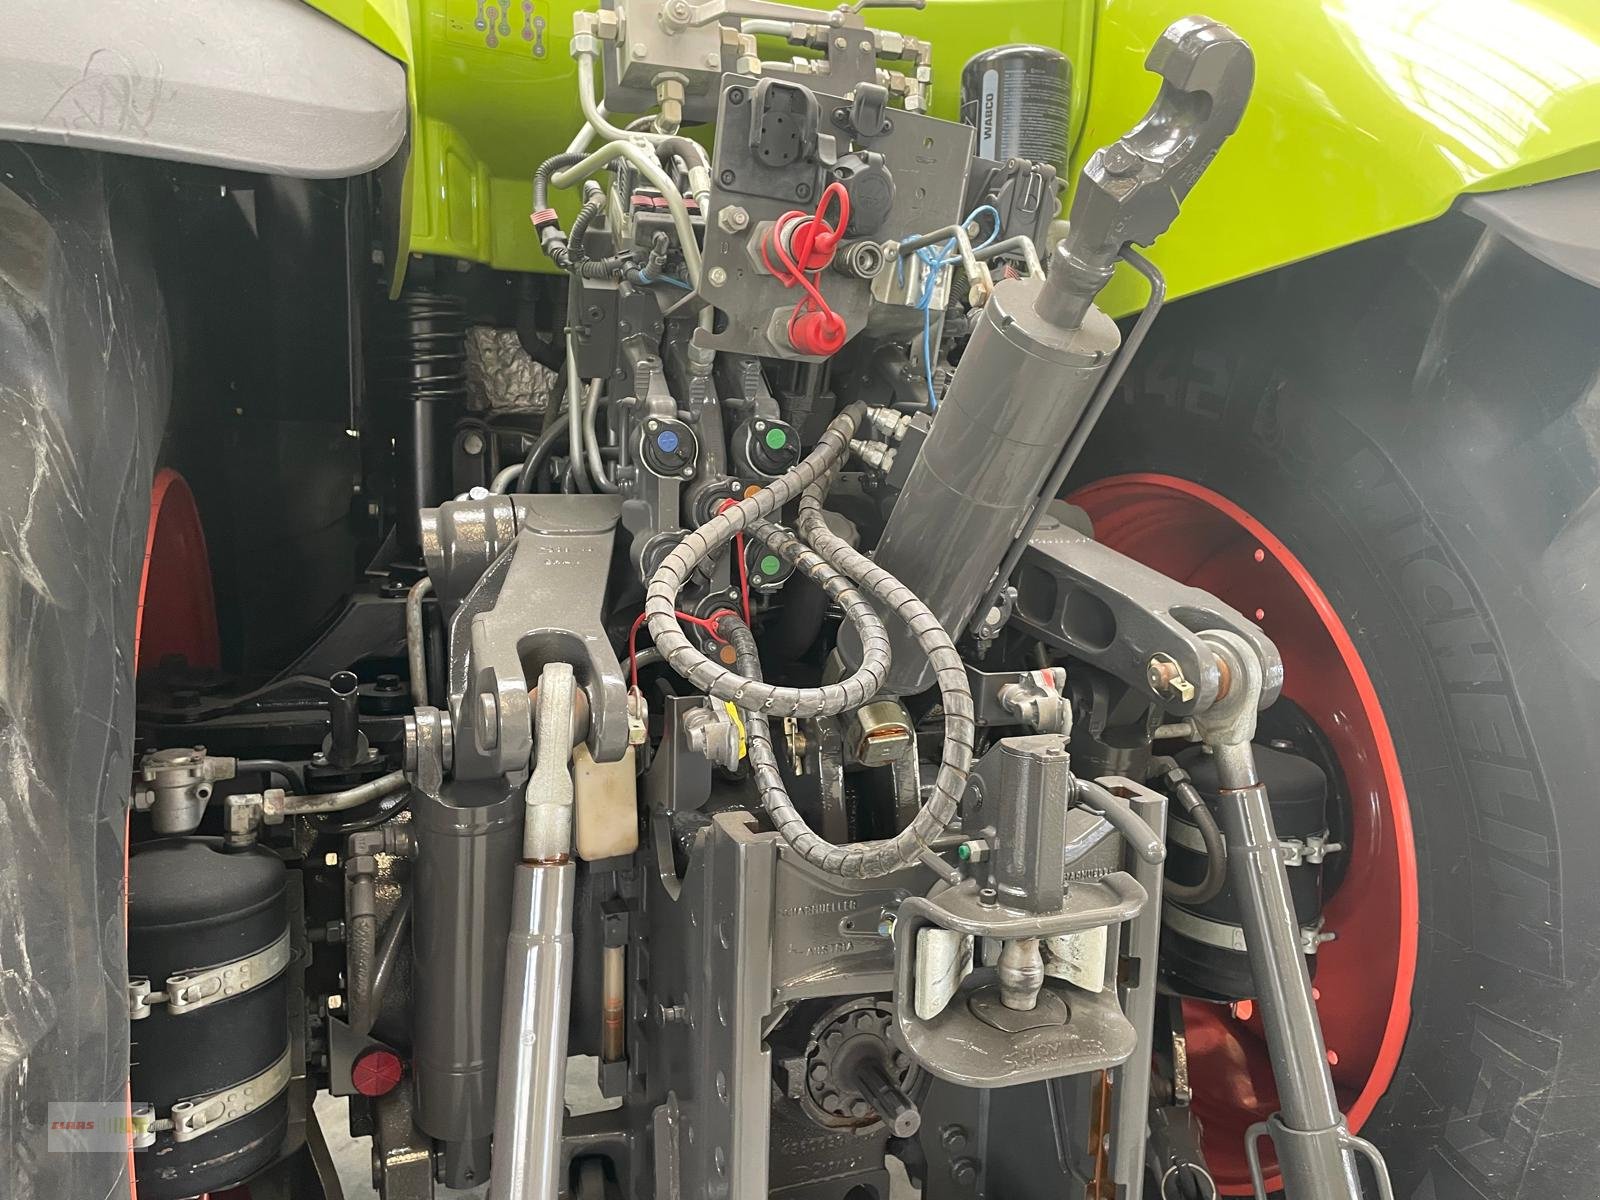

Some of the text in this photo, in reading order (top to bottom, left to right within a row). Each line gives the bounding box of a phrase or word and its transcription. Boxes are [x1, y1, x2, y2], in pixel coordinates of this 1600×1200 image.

[983, 92, 994, 140] WABCO
[1342, 446, 1555, 973] MICHELIN
[806, 941, 854, 956] AUSTRIA
